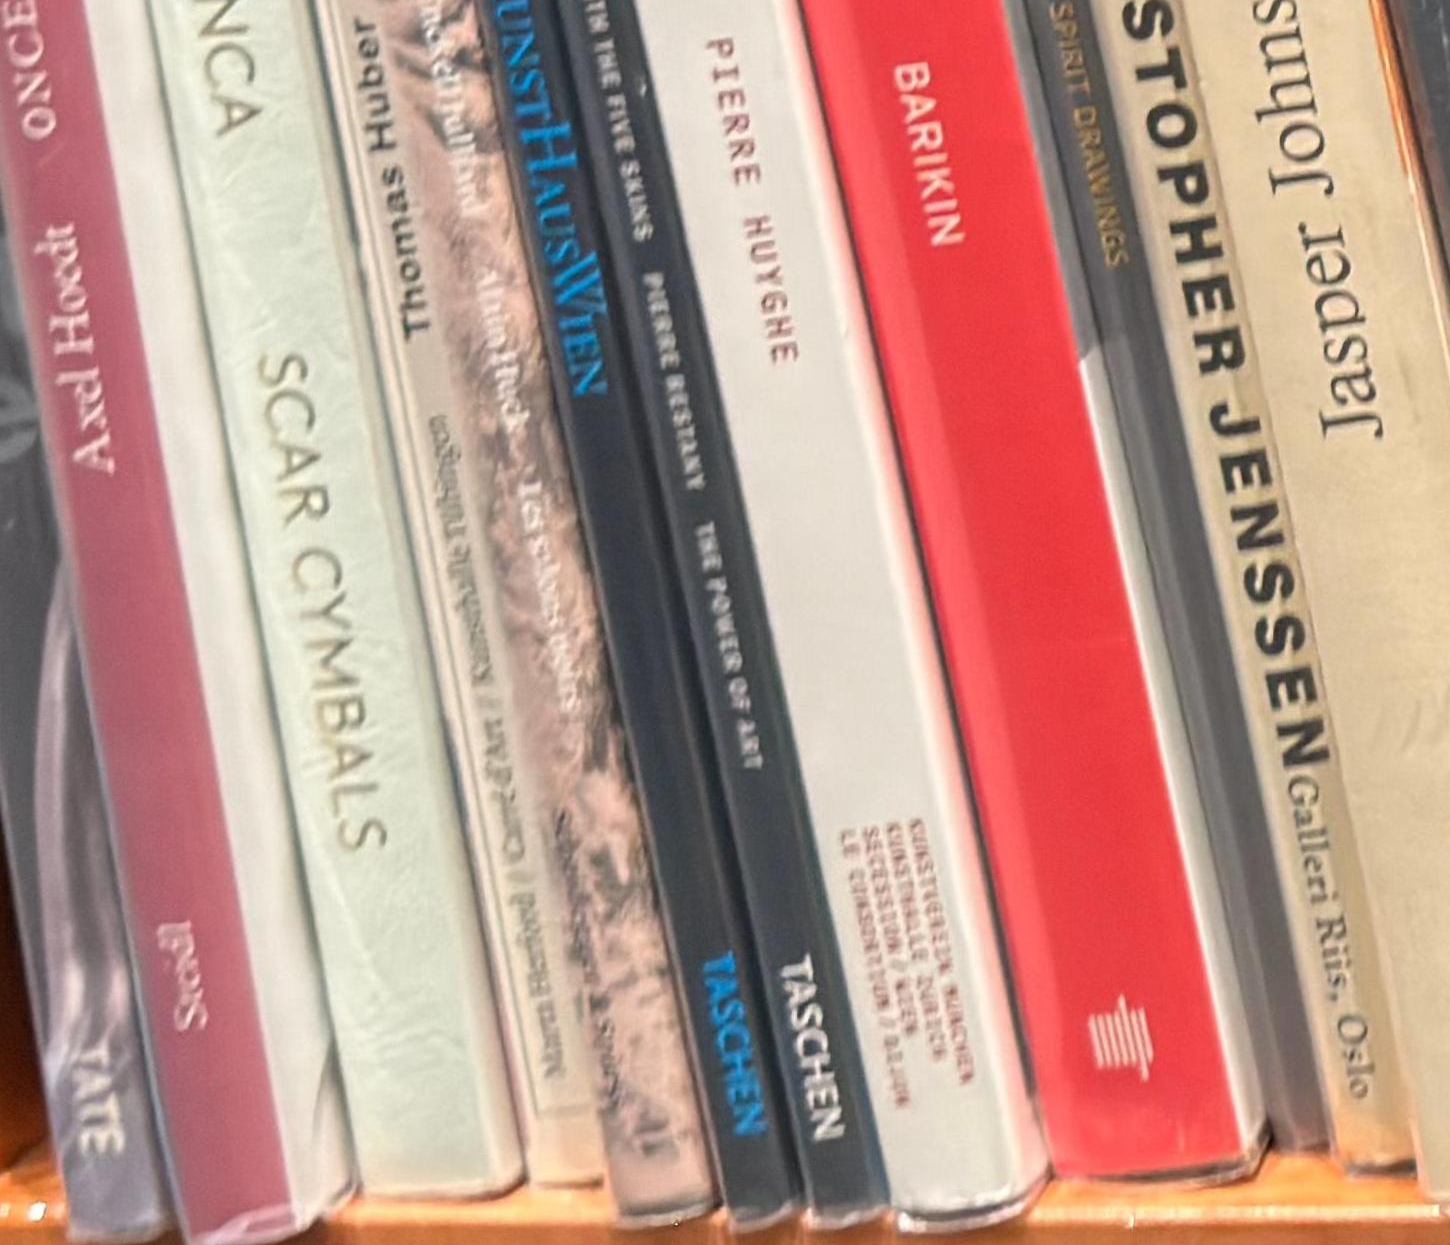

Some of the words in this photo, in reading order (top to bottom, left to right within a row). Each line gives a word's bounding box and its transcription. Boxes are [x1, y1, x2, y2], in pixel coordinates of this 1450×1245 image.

[352, 16, 399, 154] Huber
[593, 39, 622, 87] THE
[1046, 0, 1092, 96] SPIRIT
[606, 93, 636, 154] FIVE
[892, 60, 966, 248] BARIKIN
[1068, 104, 1131, 270] DRAWINGS
[379, 164, 433, 339] Thomas
[618, 159, 655, 243] SKINS
[704, 36, 763, 188] PIERRE
[742, 213, 801, 366] HUYGHE
[32, 221, 96, 357] Hoedt
[642, 271, 682, 369] PIERRE
[1296, 220, 1385, 441] Jasper
[55, 364, 117, 476] Axel
[256, 350, 332, 527] SCAR
[664, 373, 706, 491] RESTANY
[695, 520, 724, 572] THE
[1207, 400, 1332, 770] JENSSEN
[705, 576, 744, 672] POWER
[290, 545, 390, 854] CYMBALS
[726, 676, 753, 713] OF
[735, 717, 765, 770] ART
[860, 823, 905, 956] SECESSION
[1285, 774, 1341, 905] Galleri
[1313, 912, 1354, 1004] Riis,
[1335, 1012, 1378, 1101] Oslo
[72, 1043, 126, 1158] TATE
[700, 950, 764, 1137] TASCHEN
[780, 953, 847, 1142] TASCHEN
